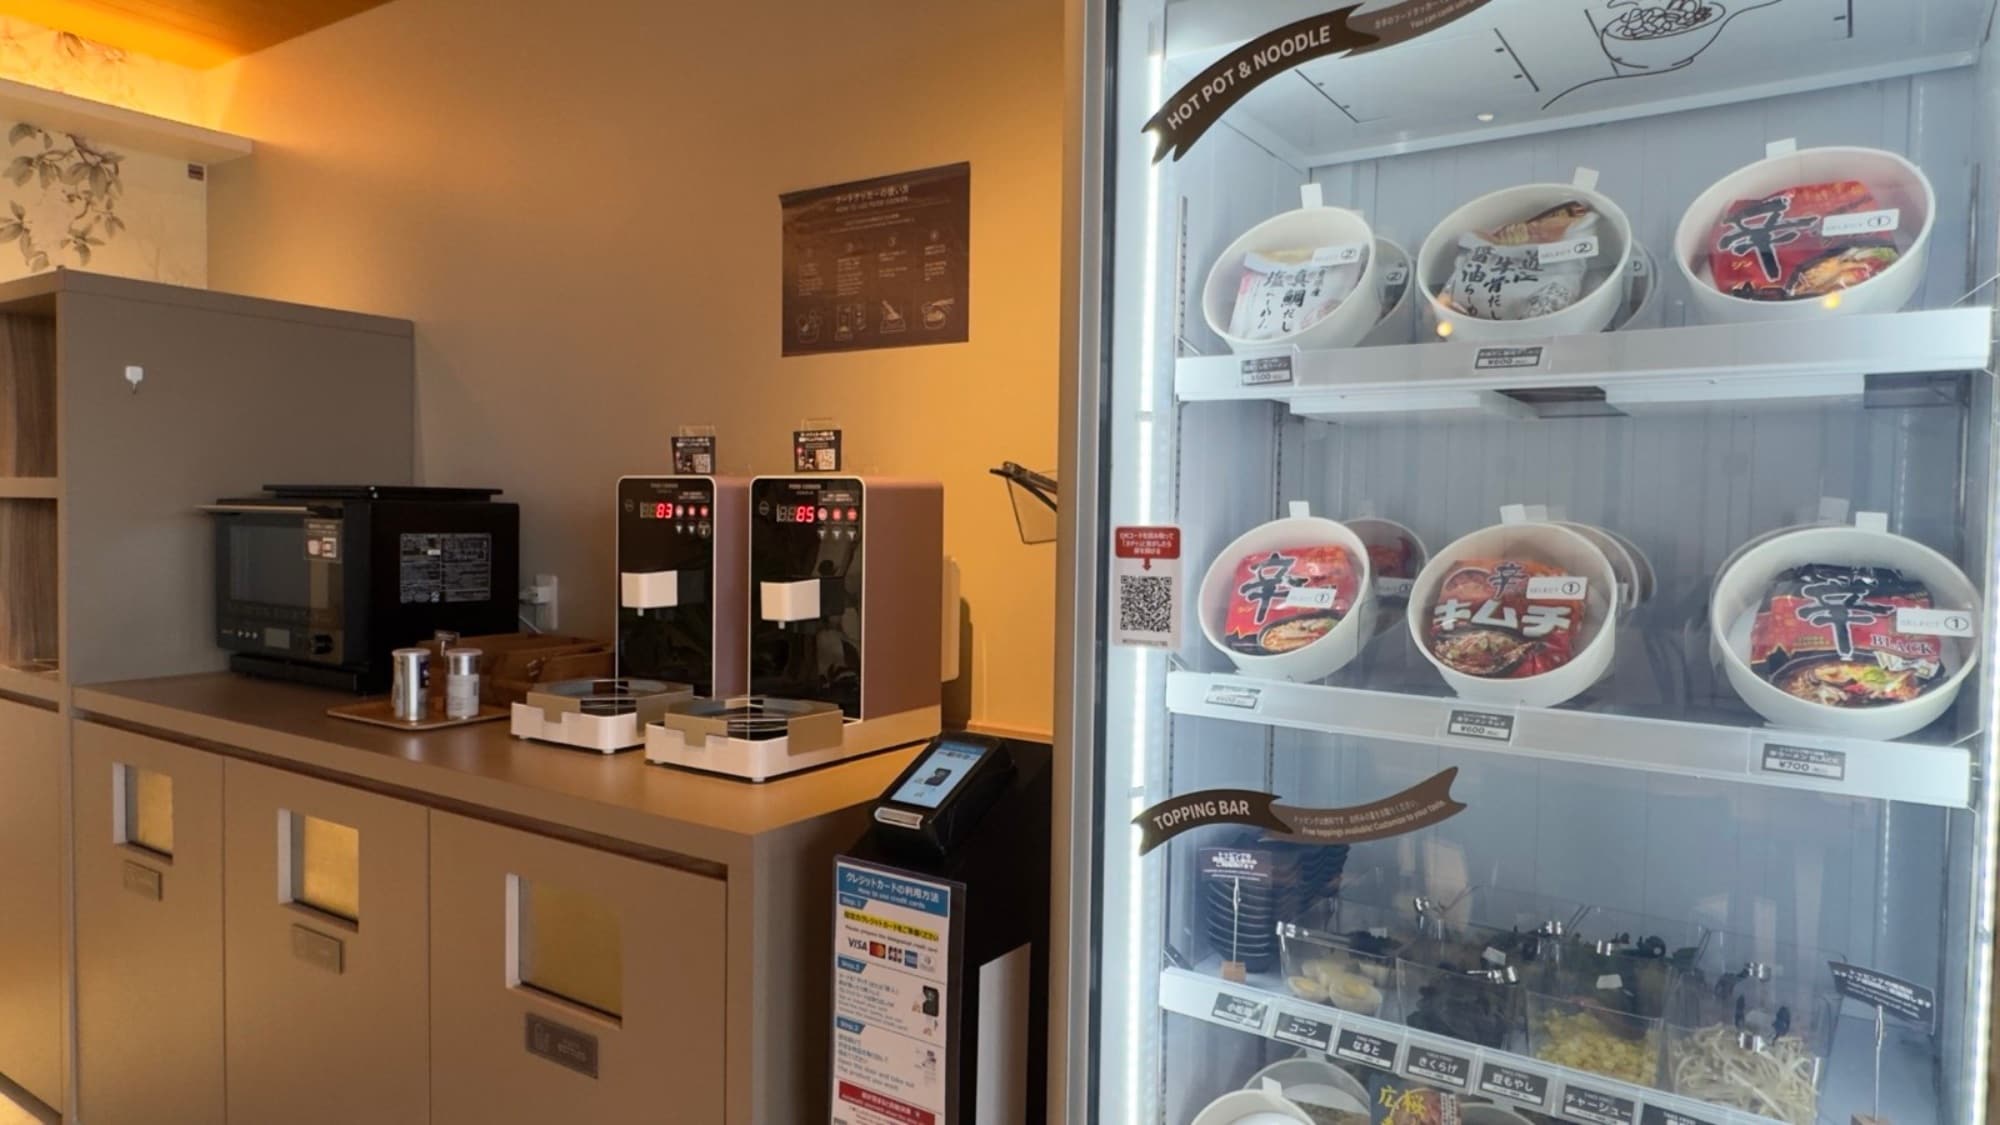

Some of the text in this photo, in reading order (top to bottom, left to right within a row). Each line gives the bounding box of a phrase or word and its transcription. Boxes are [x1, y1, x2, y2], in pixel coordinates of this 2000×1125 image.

[1166, 25, 1331, 130] HOT POT & NOODLE
[1717, 194, 1822, 283] 辛
[655, 503, 674, 519] 83
[795, 506, 815, 523] 85
[1433, 598, 1572, 639] キムチ
[1870, 633, 1934, 656] BLACK
[1460, 724, 1485, 734] ¥600
[1779, 761, 1809, 772] ¥700
[1153, 799, 1250, 831] TOPPING BAR
[846, 872, 940, 903] クレジットカードの利用方法
[847, 938, 868, 951] VISA
[1289, 1023, 1317, 1036] コーン
[1352, 1041, 1380, 1056] なると
[1418, 1056, 1458, 1074] きくらげ
[1492, 1072, 1534, 1092] 豆もやし
[1565, 1093, 1632, 1116] チャーシュー
